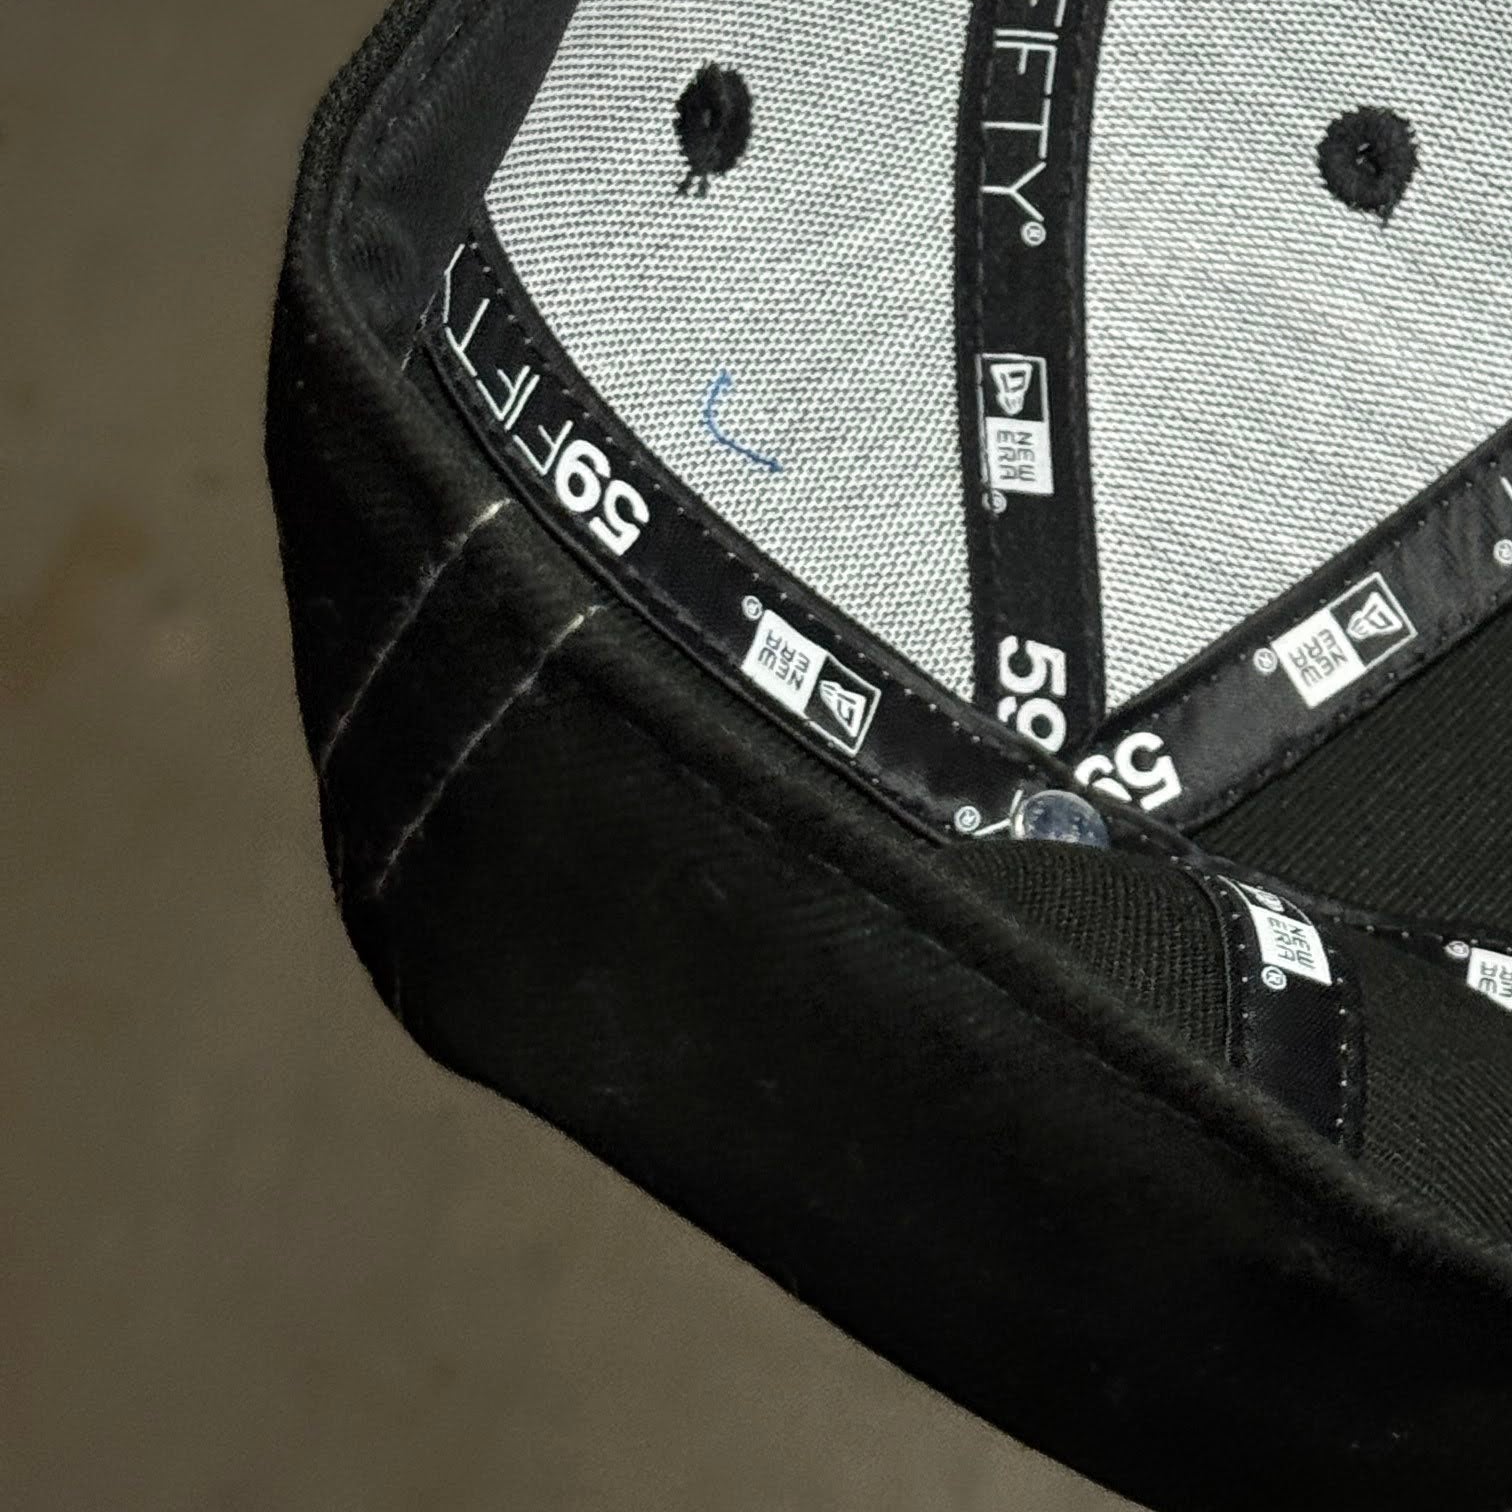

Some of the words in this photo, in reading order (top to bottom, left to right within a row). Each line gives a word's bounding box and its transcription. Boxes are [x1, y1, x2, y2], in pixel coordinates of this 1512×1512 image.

[997, 430, 1017, 480] ERA
[1016, 431, 1036, 482] NEW
[758, 646, 804, 691] NEW
[766, 629, 810, 673] ERA
[1288, 628, 1336, 669] ERA
[1300, 645, 1348, 687] NEW
[1267, 917, 1295, 961] ERA
[1289, 924, 1316, 969] NEW
